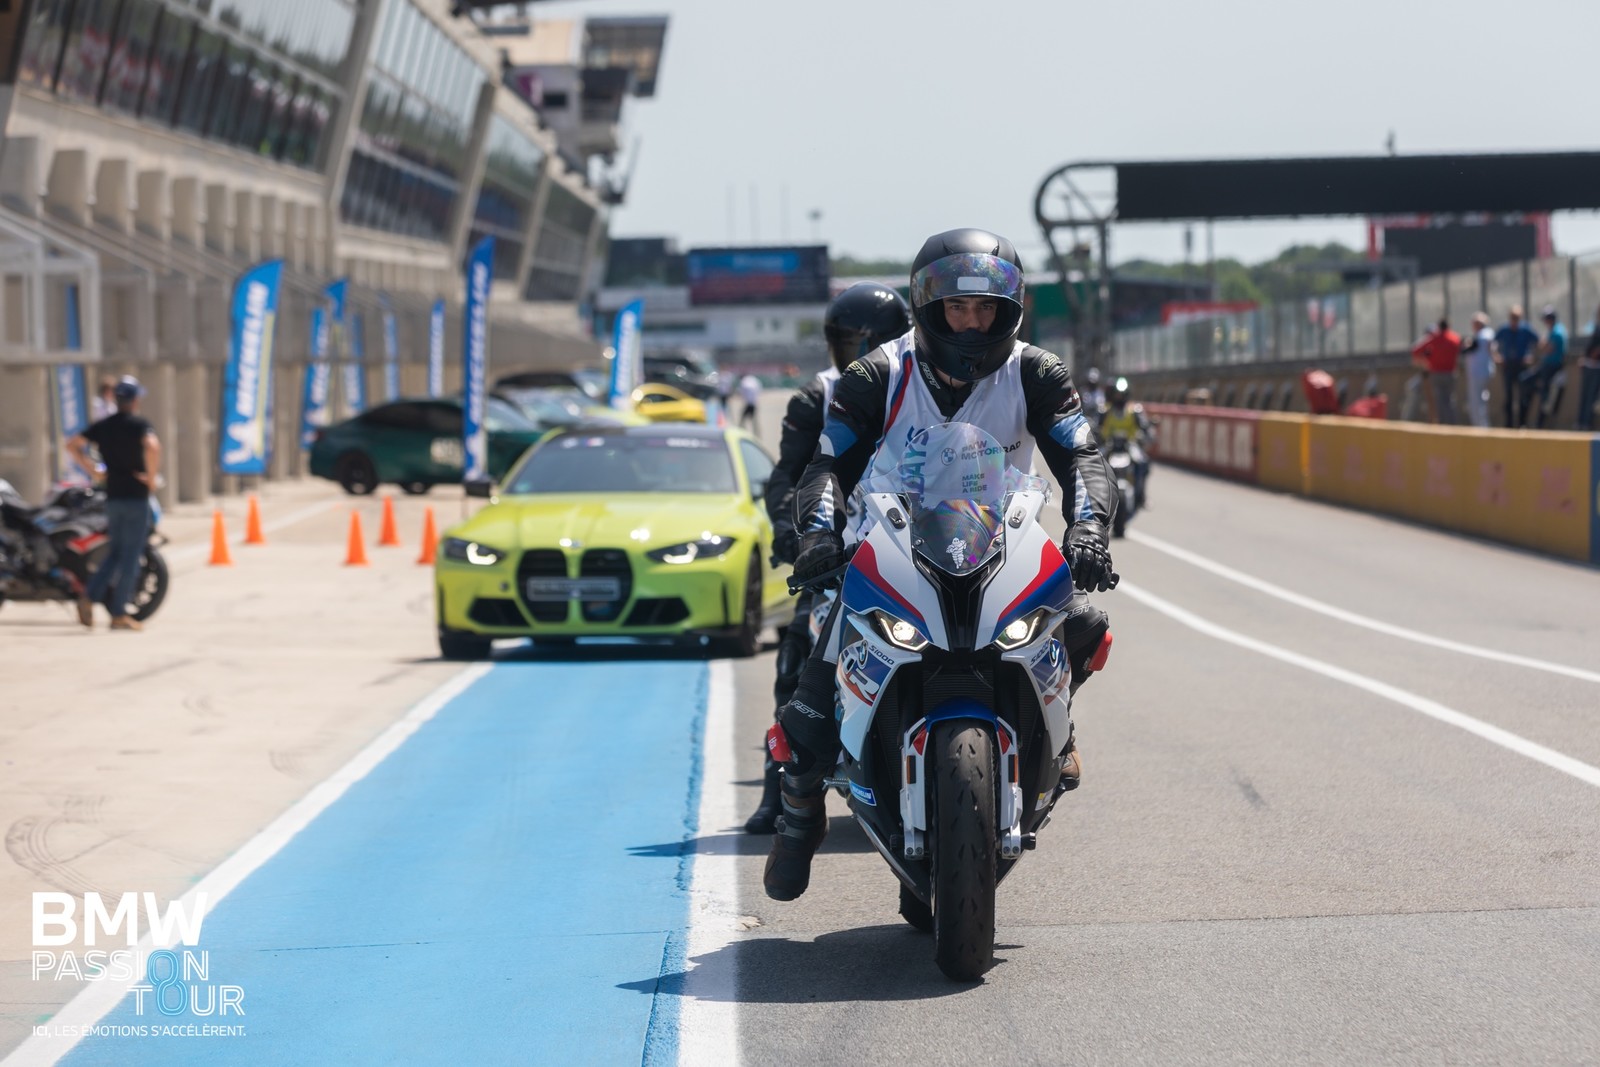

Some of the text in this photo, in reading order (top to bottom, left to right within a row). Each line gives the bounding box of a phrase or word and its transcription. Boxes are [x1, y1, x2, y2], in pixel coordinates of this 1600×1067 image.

[961, 440, 988, 452] BMW
[961, 473, 985, 481] MAKE
[962, 480, 979, 488] LIFE
[969, 484, 988, 493] RIDE
[790, 699, 826, 719] RST
